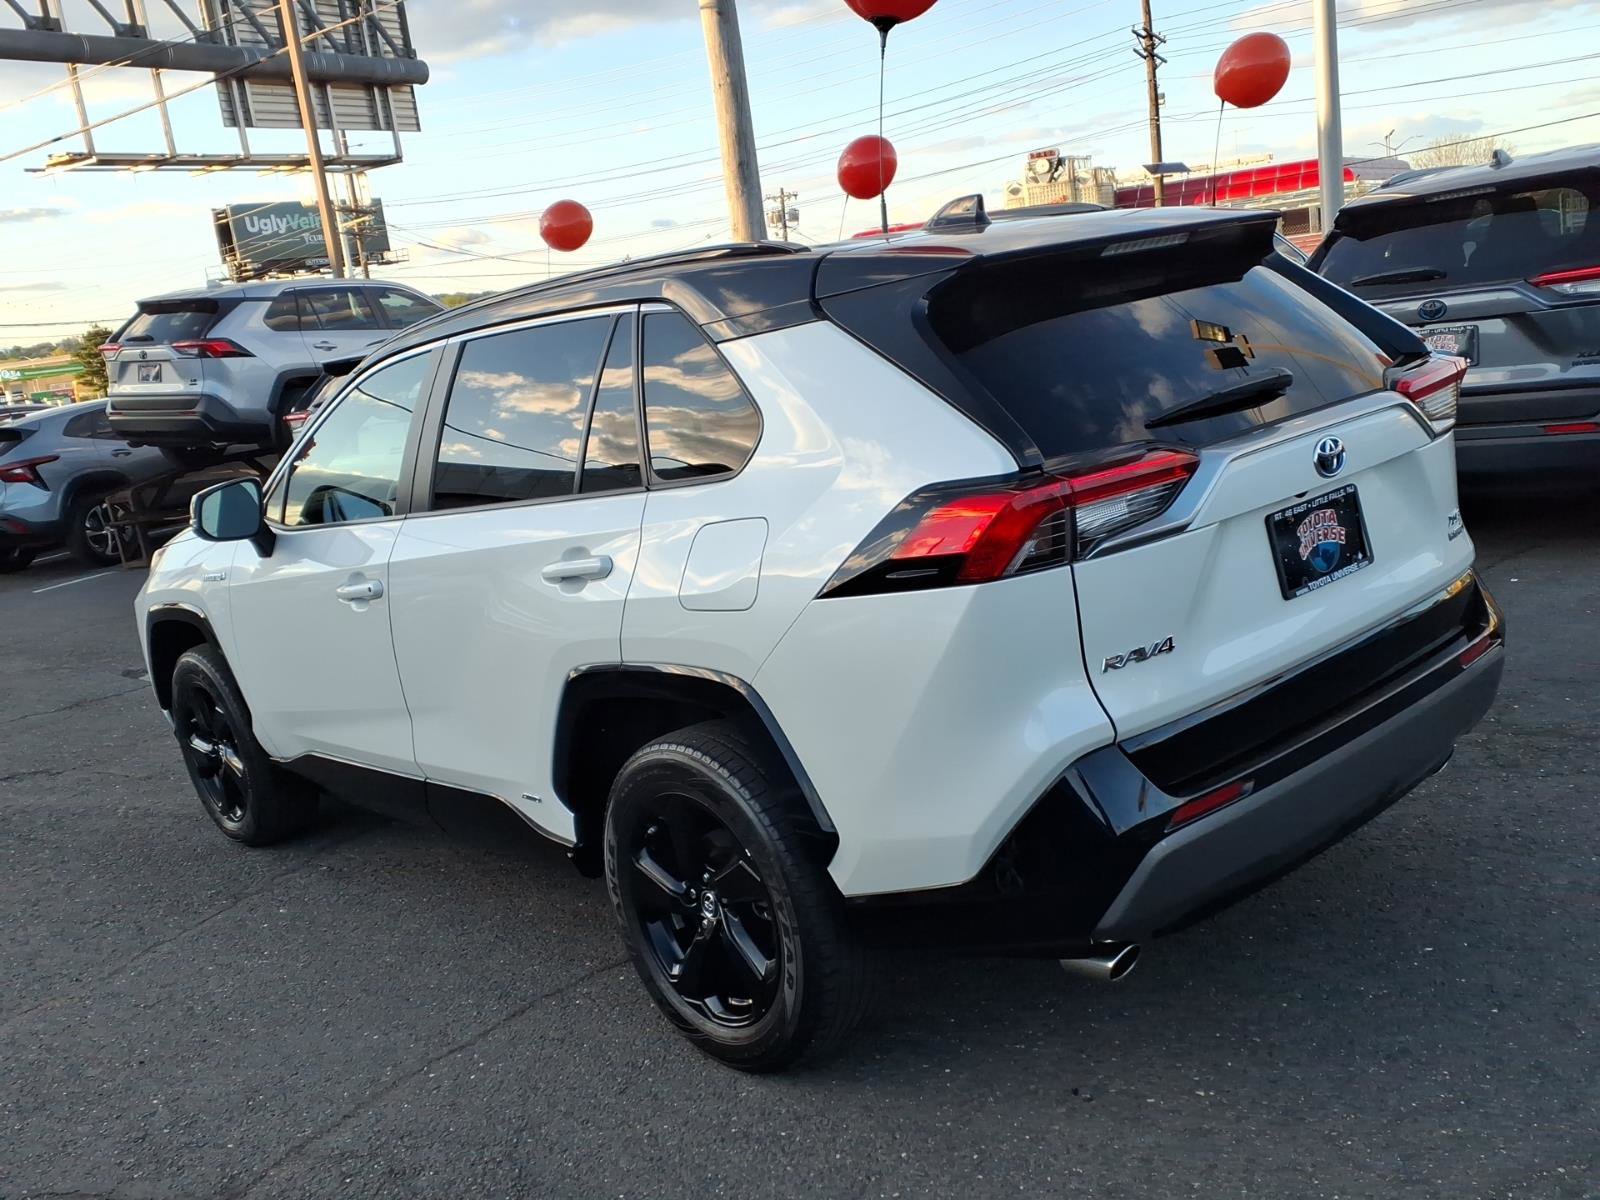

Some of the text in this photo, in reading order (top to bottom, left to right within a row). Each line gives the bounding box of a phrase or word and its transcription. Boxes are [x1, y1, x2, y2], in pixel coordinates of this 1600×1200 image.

[1293, 503, 1308, 514] EAST
[1311, 495, 1329, 508] LITTLE
[1346, 485, 1355, 494] NJ
[1296, 509, 1338, 540] TOYOTA
[1299, 526, 1346, 560] UNIVERSE
[1101, 634, 1176, 674] RAV4
